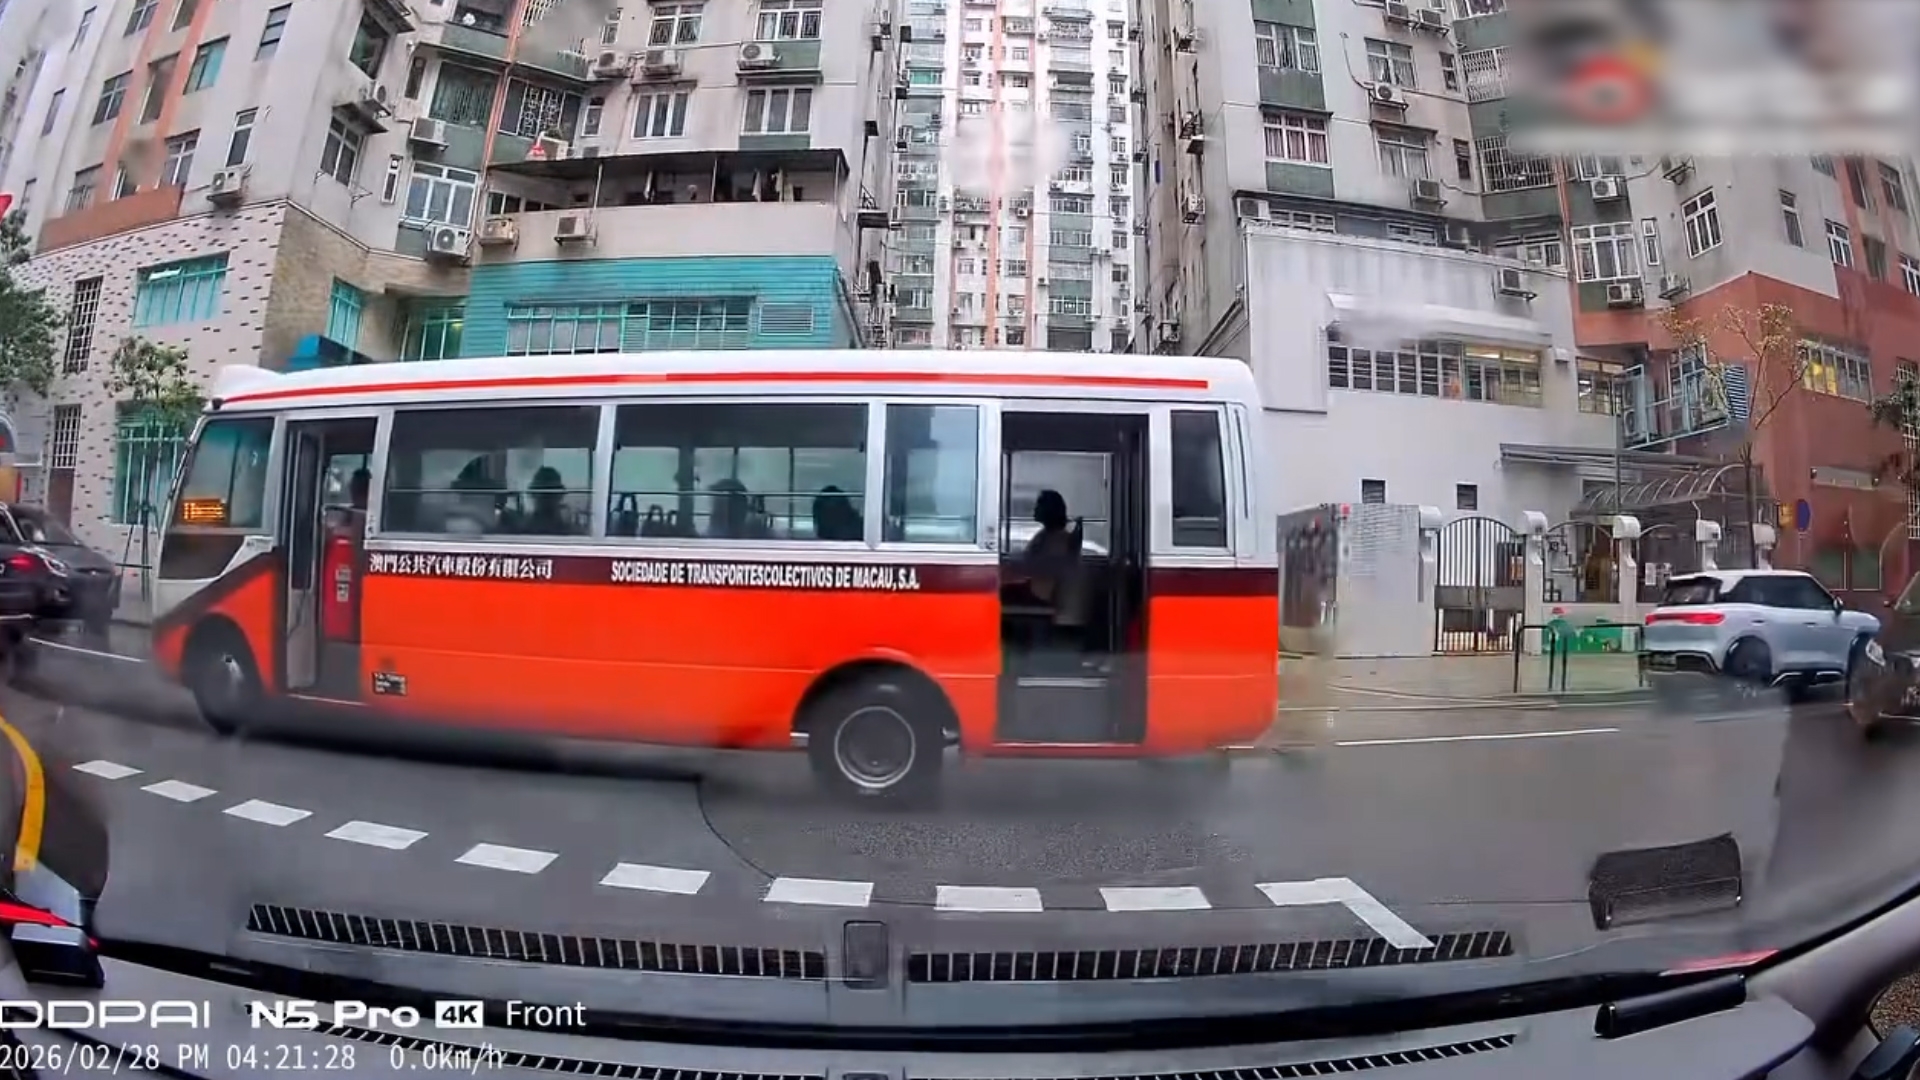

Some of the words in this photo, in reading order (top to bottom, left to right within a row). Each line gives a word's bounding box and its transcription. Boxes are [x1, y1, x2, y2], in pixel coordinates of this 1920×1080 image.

[369, 553, 553, 579] 澳門公共汽車股份有限公司
[611, 561, 669, 583] SOCIEDADE
[670, 563, 684, 583] DE
[835, 566, 851, 588] DE
[852, 566, 897, 591] MACAU,
[898, 567, 920, 589] S.A.
